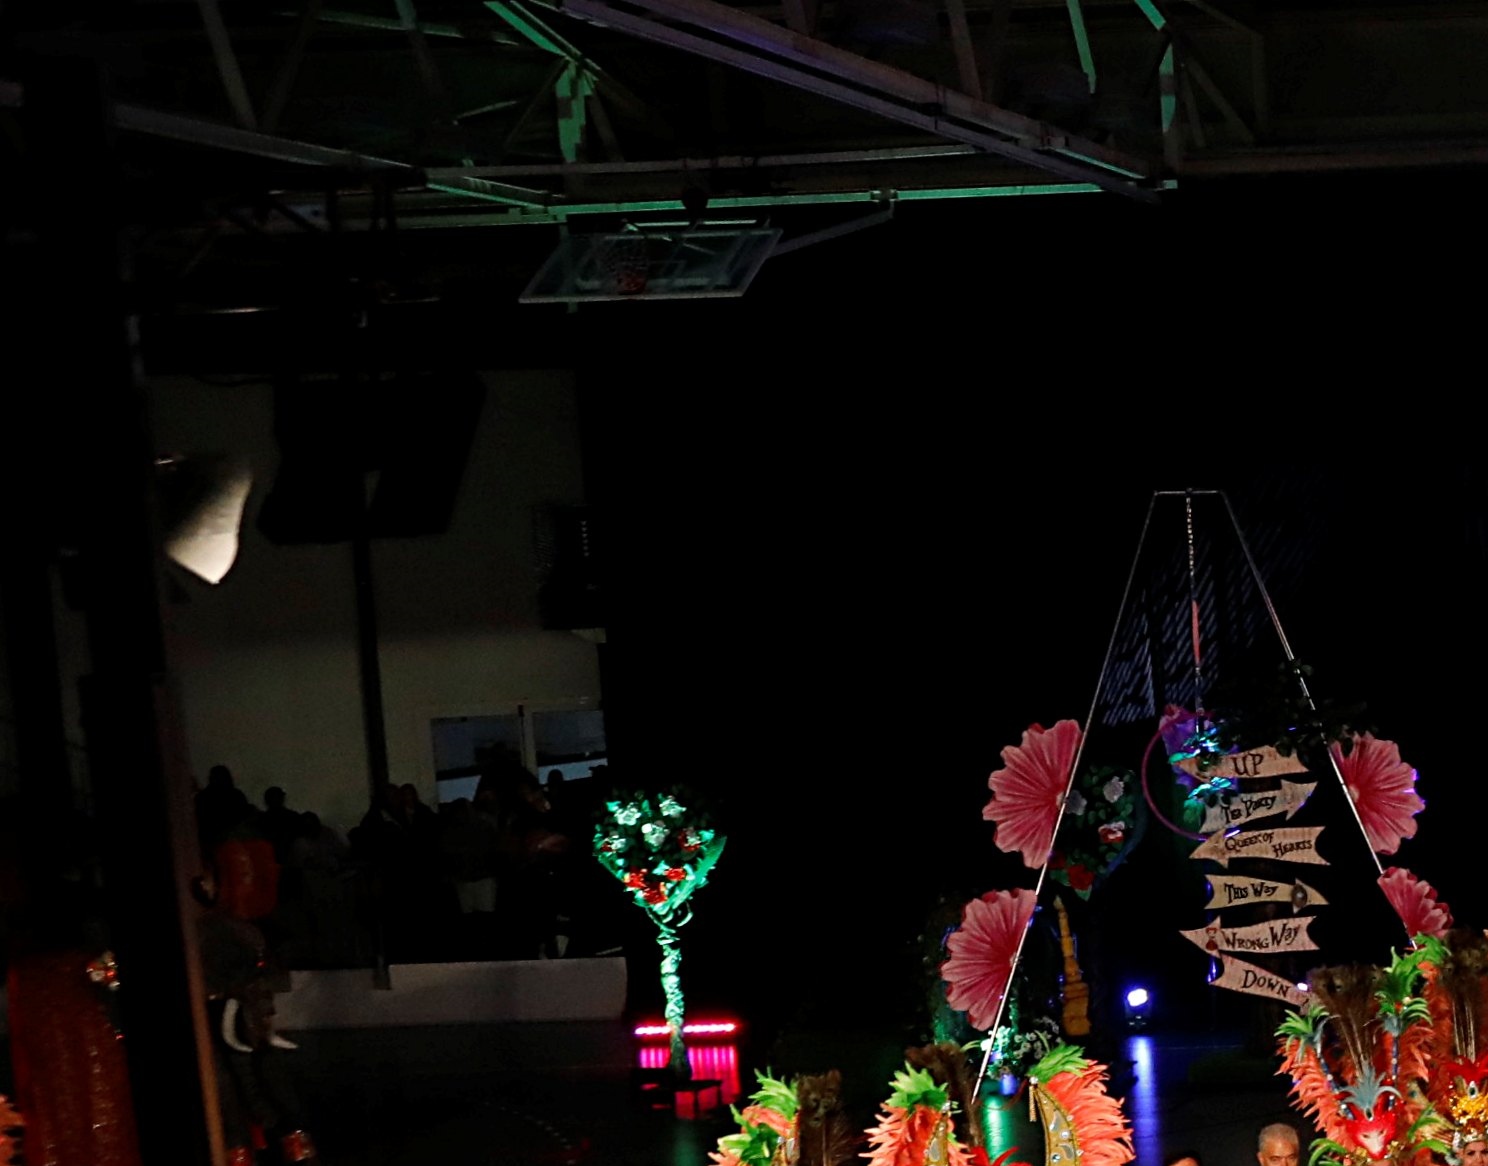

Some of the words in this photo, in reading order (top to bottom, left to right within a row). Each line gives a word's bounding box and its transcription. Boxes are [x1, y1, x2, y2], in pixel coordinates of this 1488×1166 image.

[1230, 752, 1264, 776] UP
[1250, 882, 1279, 898] Way
[1269, 923, 1301, 947] Way
[1242, 969, 1291, 998] DOWN
